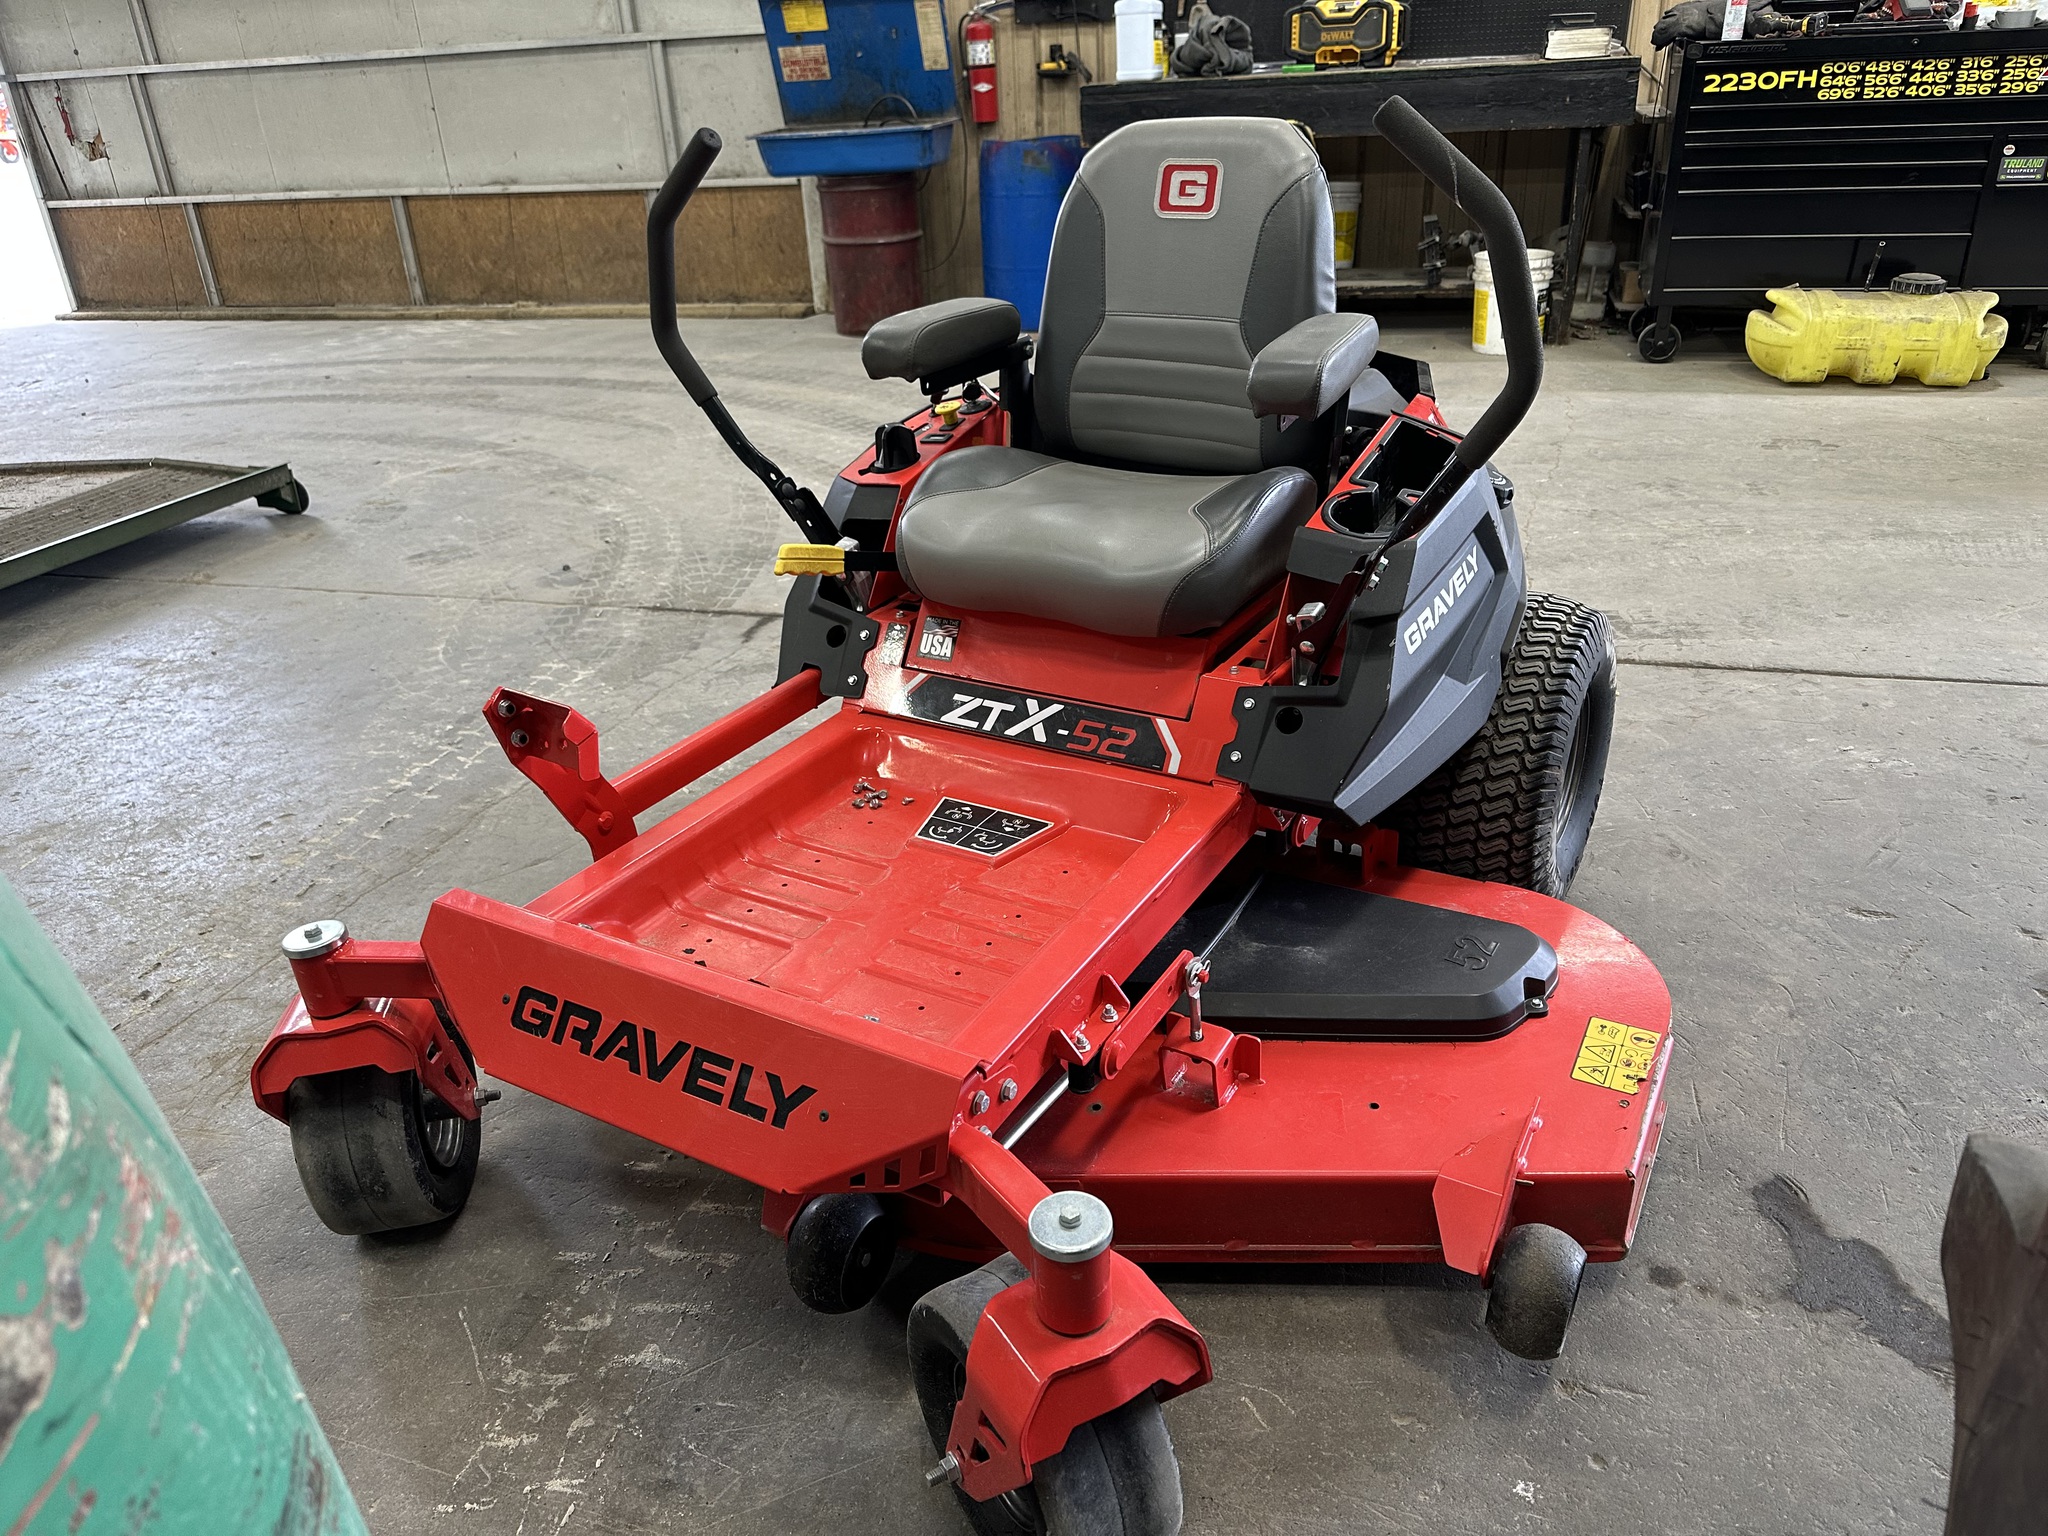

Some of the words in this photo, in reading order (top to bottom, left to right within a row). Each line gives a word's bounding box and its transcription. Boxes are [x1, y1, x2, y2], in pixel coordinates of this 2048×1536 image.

[1821, 62, 1866, 74] 60'6"
[1865, 60, 1910, 72] 48'6"
[1911, 58, 1956, 70] 42'6"
[1961, 56, 1999, 69] 31'6"
[2004, 54, 2048, 67] 25'6"
[1703, 69, 1818, 93] 2230FH
[1820, 75, 1862, 87] 64'6"
[1864, 73, 1907, 86] 56'6"
[1909, 71, 1953, 84] 44'6"
[1955, 69, 2000, 82] 33'6"
[1817, 88, 1860, 100] 69'6"
[1862, 86, 1905, 99] 52'6"
[1905, 84, 1951, 97] 40'6"
[1953, 83, 1997, 96] 35'6"
[1998, 81, 2044, 94] 29'6"
[2003, 158, 2045, 168] TRULAND
[1403, 545, 1479, 655] GRAVELY
[926, 616, 942, 624] MADE
[920, 633, 953, 657] USA
[940, 693, 1137, 759] ZTX-52
[1444, 934, 1500, 971] 52
[510, 985, 818, 1130] GRAVELY
